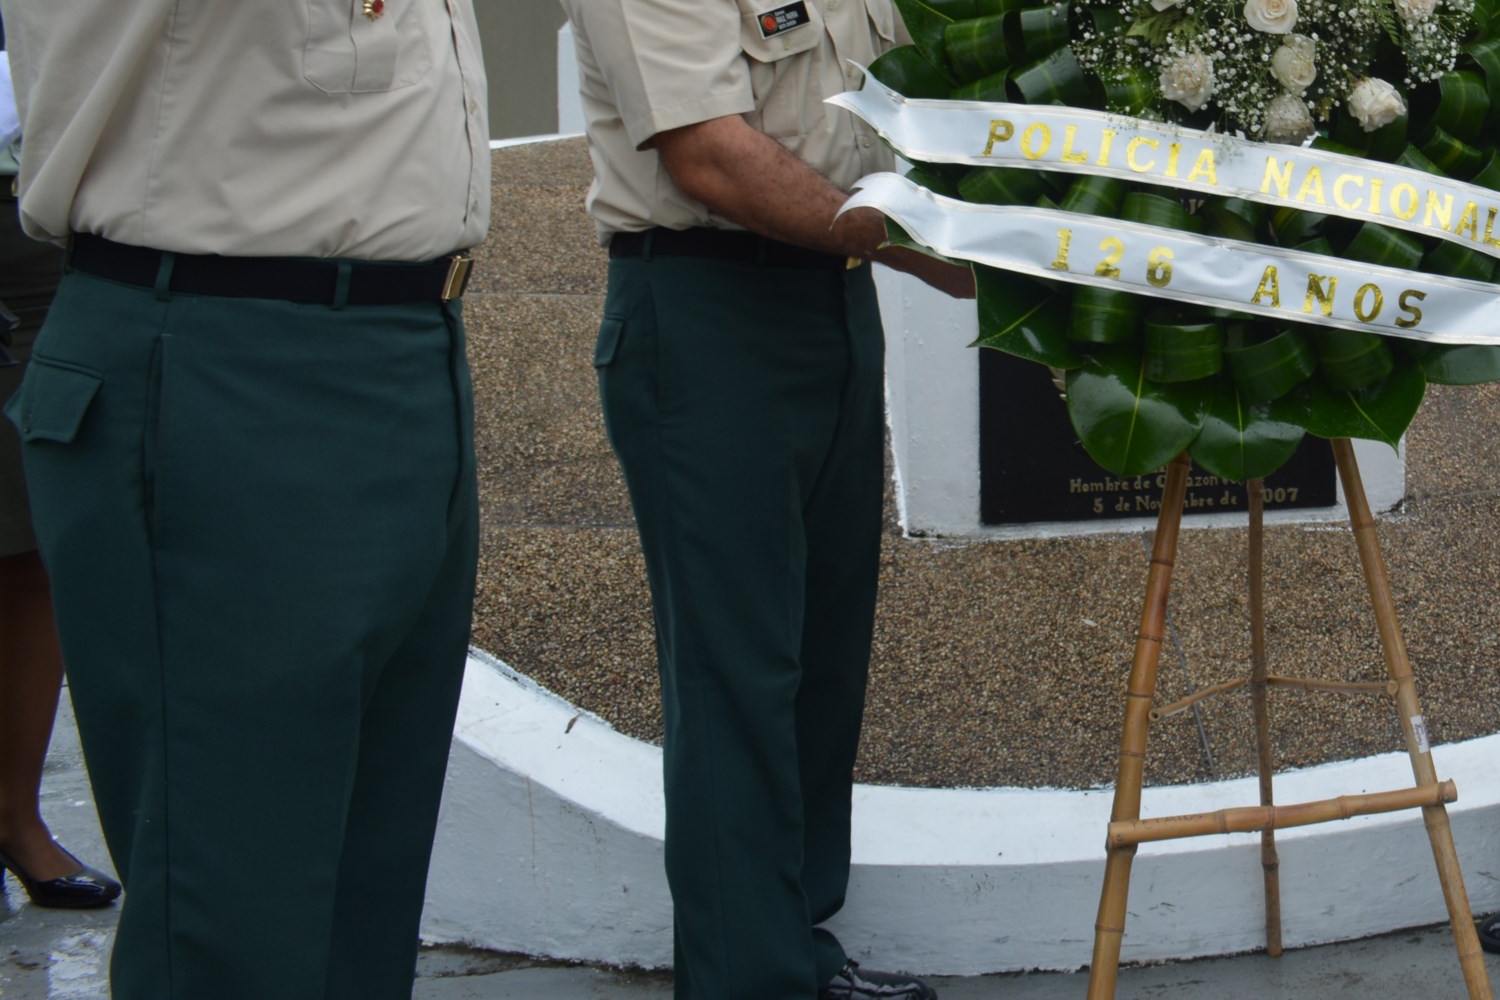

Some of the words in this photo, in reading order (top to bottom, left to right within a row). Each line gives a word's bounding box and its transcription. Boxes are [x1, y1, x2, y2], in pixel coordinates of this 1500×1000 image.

[982, 119, 1218, 186] POLICIA
[1051, 228, 1175, 288] 126
[1069, 477, 1130, 494] Hombre
[1133, 475, 1151, 490] de
[1092, 497, 1104, 514] 5
[1114, 496, 1131, 512] de
[1220, 490, 1238, 505] de
[1263, 487, 1299, 503] 007
